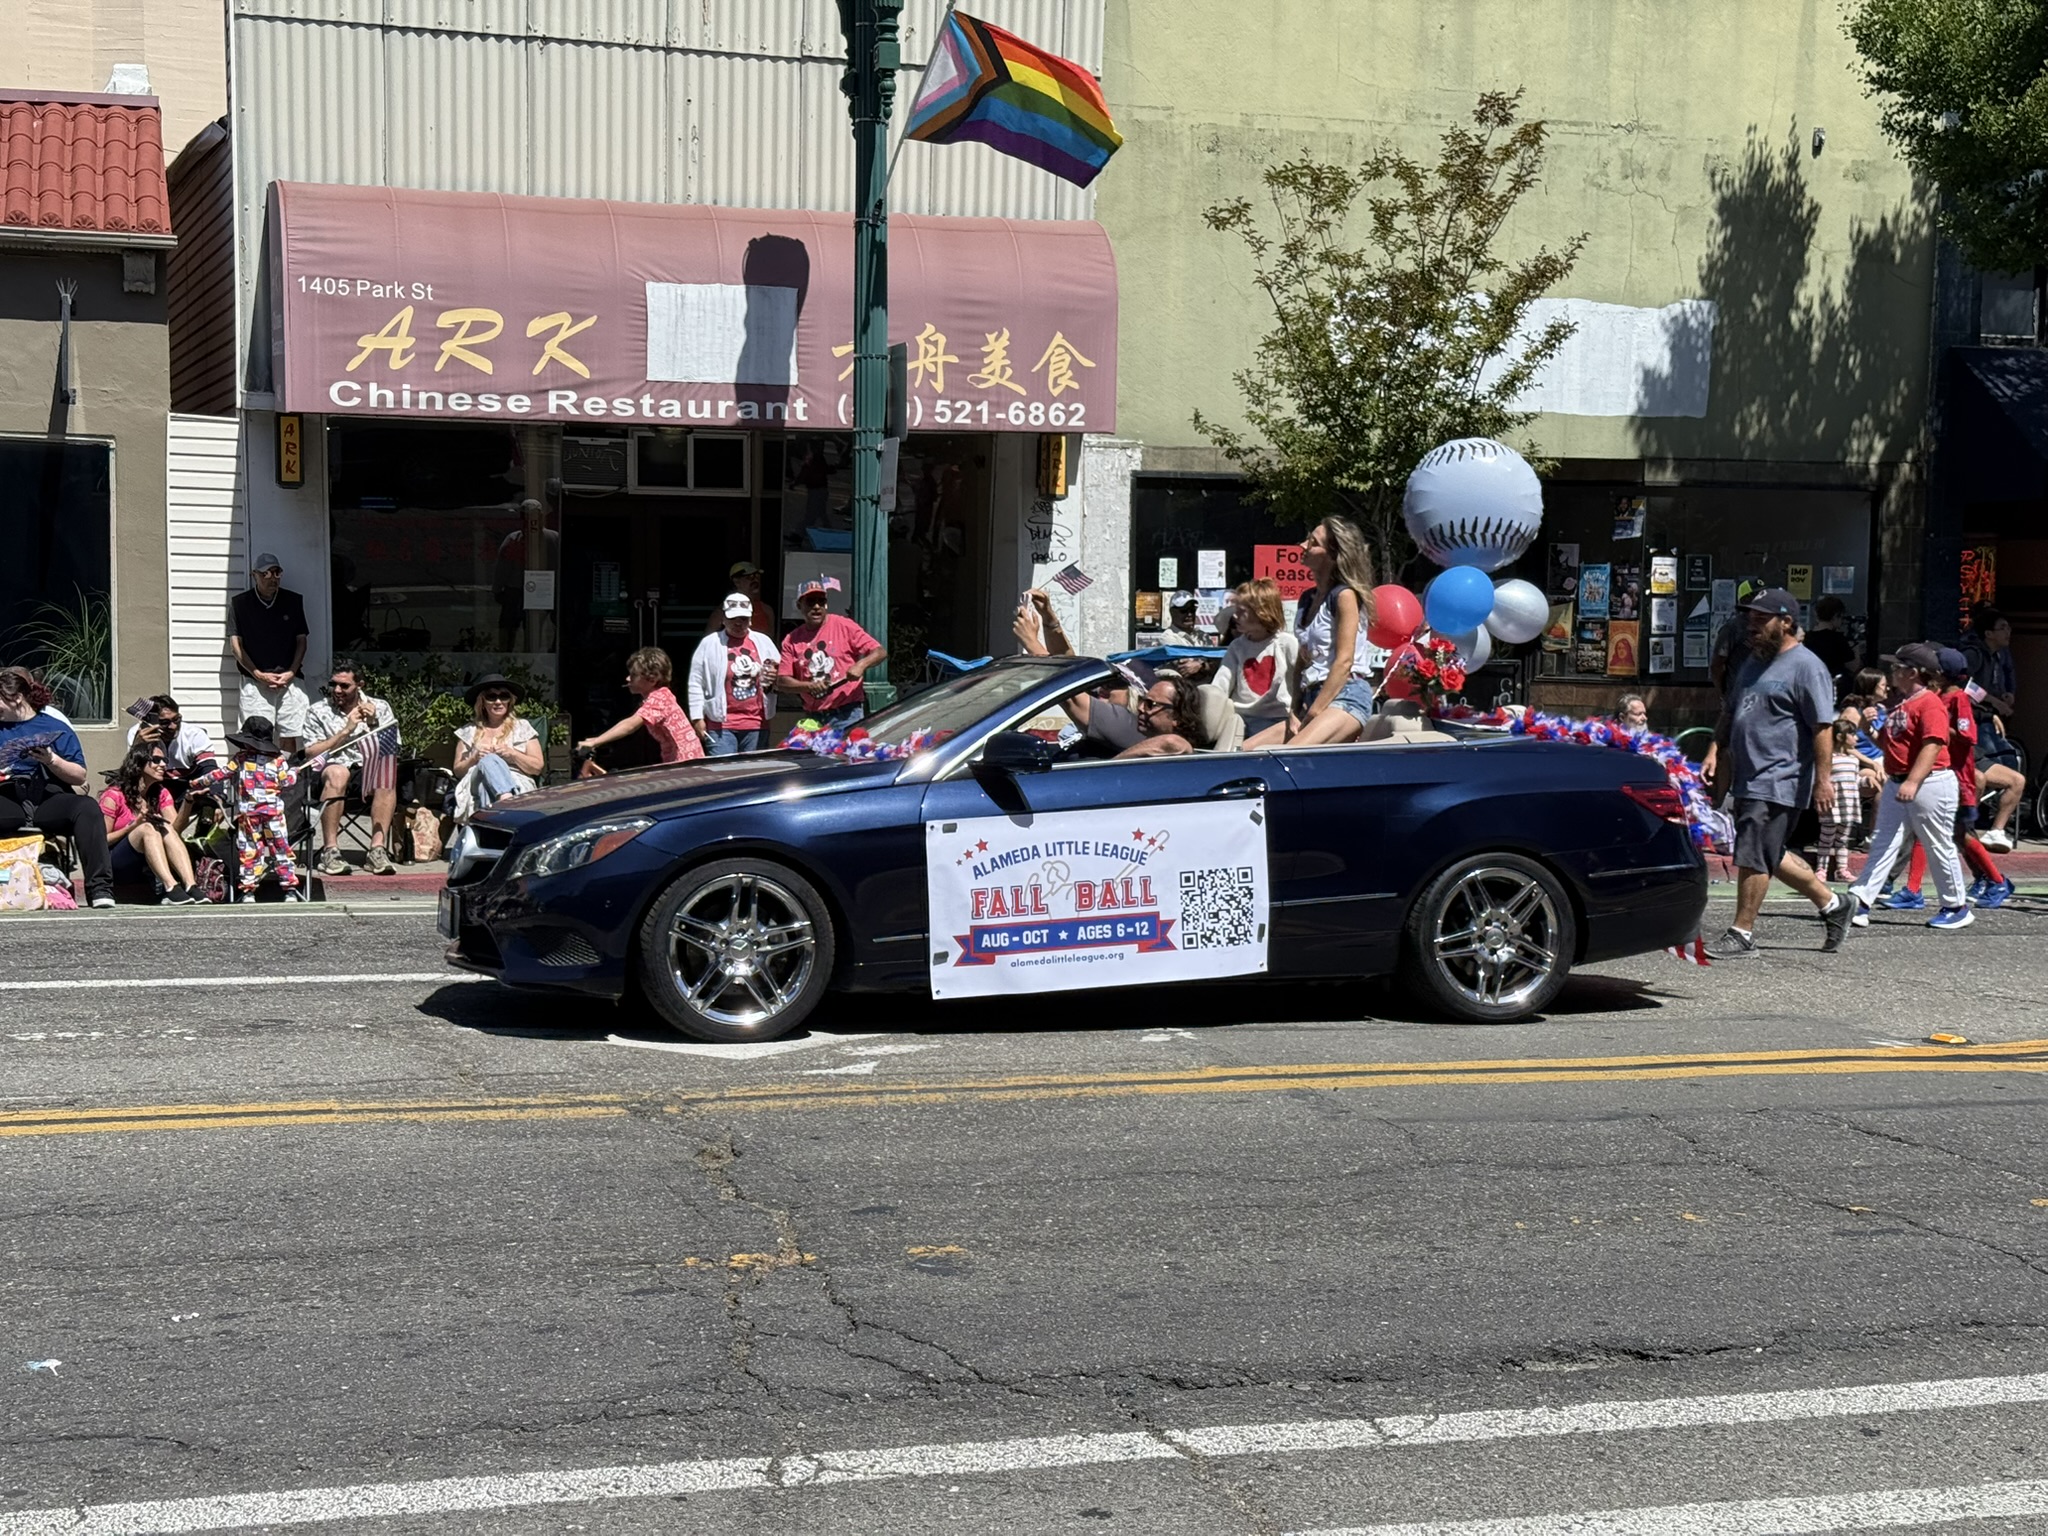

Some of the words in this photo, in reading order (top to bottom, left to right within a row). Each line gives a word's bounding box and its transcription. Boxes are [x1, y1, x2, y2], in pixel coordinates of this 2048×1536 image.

[298, 275, 350, 296] 1405
[356, 279, 405, 299] Park
[411, 282, 434, 300] St
[345, 305, 599, 379] ARK
[329, 380, 532, 413] Chinese
[548, 389, 809, 421] Restaurant
[934, 400, 1086, 427] 521-6862
[283, 422, 298, 475] ARK
[1276, 548, 1305, 563] Fo
[1791, 567, 1809, 576] IMP
[972, 844, 1041, 880] ALAMEDA
[1044, 840, 1091, 858] LITTLE
[1094, 841, 1149, 866] LEAGUE
[970, 884, 1049, 919] FALL
[1074, 875, 1158, 912] BALL
[1077, 924, 1112, 941] AGES
[1116, 921, 1150, 937] 6-12
[1010, 952, 1125, 968] alamedalittleleague.org
